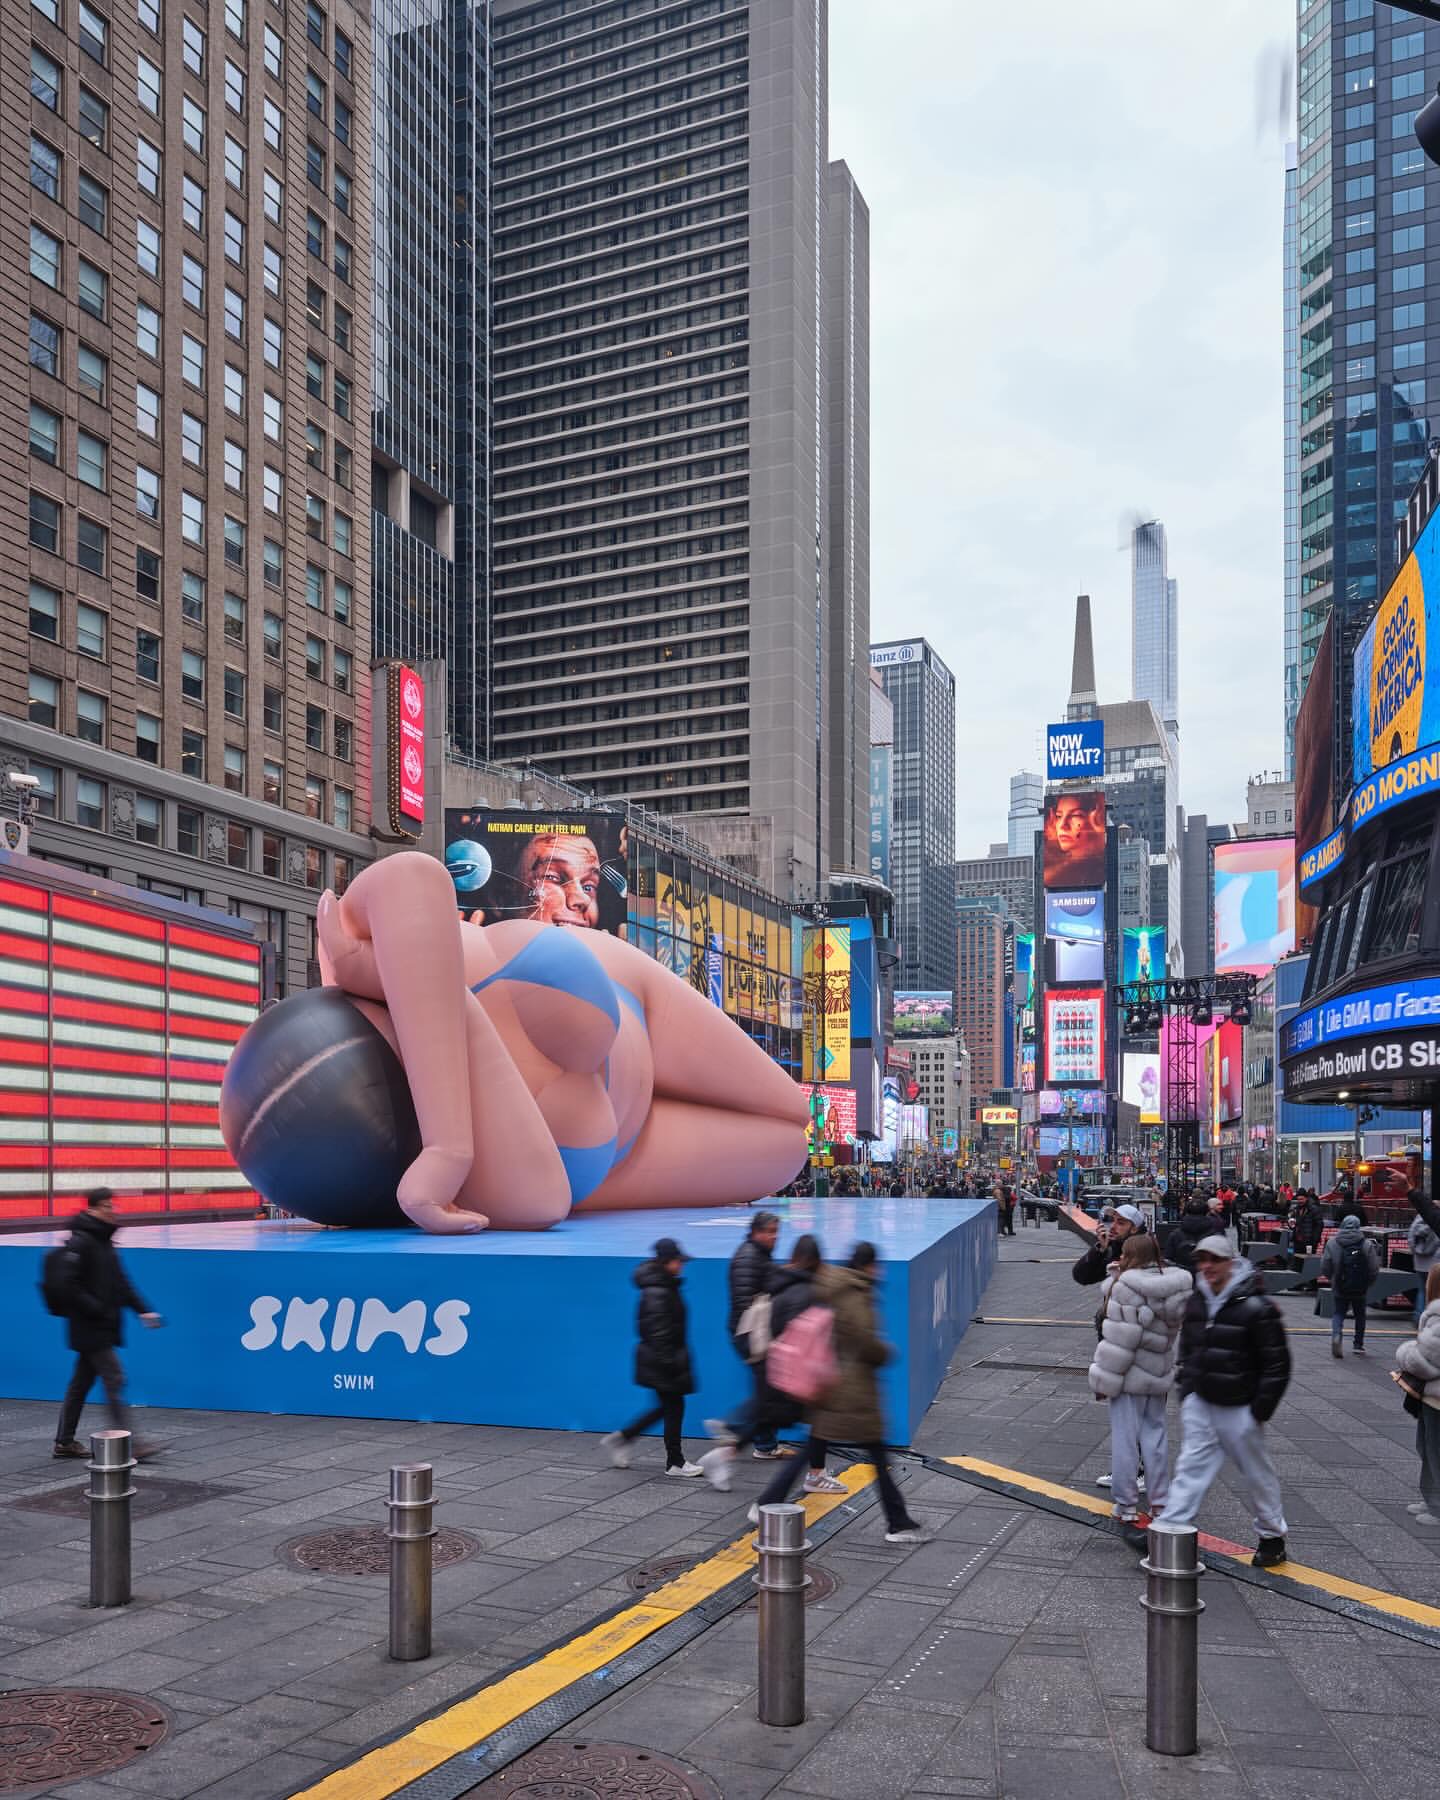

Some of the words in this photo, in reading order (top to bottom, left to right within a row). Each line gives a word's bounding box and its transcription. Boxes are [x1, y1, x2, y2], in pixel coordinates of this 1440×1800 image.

[1383, 595, 1408, 656] GOOD
[1376, 617, 1416, 698] MORNING
[1372, 644, 1422, 746] AMERICA
[1049, 733, 1083, 751] NOW
[1049, 748, 1101, 767] WHAT?
[487, 823, 513, 833] NATHAN
[534, 823, 554, 834] CAN'T
[555, 824, 569, 834] FEEL
[570, 824, 586, 835] PAIN
[1052, 896, 1096, 907] SAMSUNG
[746, 930, 766, 955] THE
[1343, 1000, 1371, 1028] GMA
[1373, 1001, 1393, 1022] on
[1319, 1056, 1335, 1080] Pro
[1336, 1048, 1367, 1076] Bowl
[1370, 1044, 1403, 1071] CB
[240, 1295, 471, 1356] SKIMS
[333, 1374, 374, 1390] SWIM
